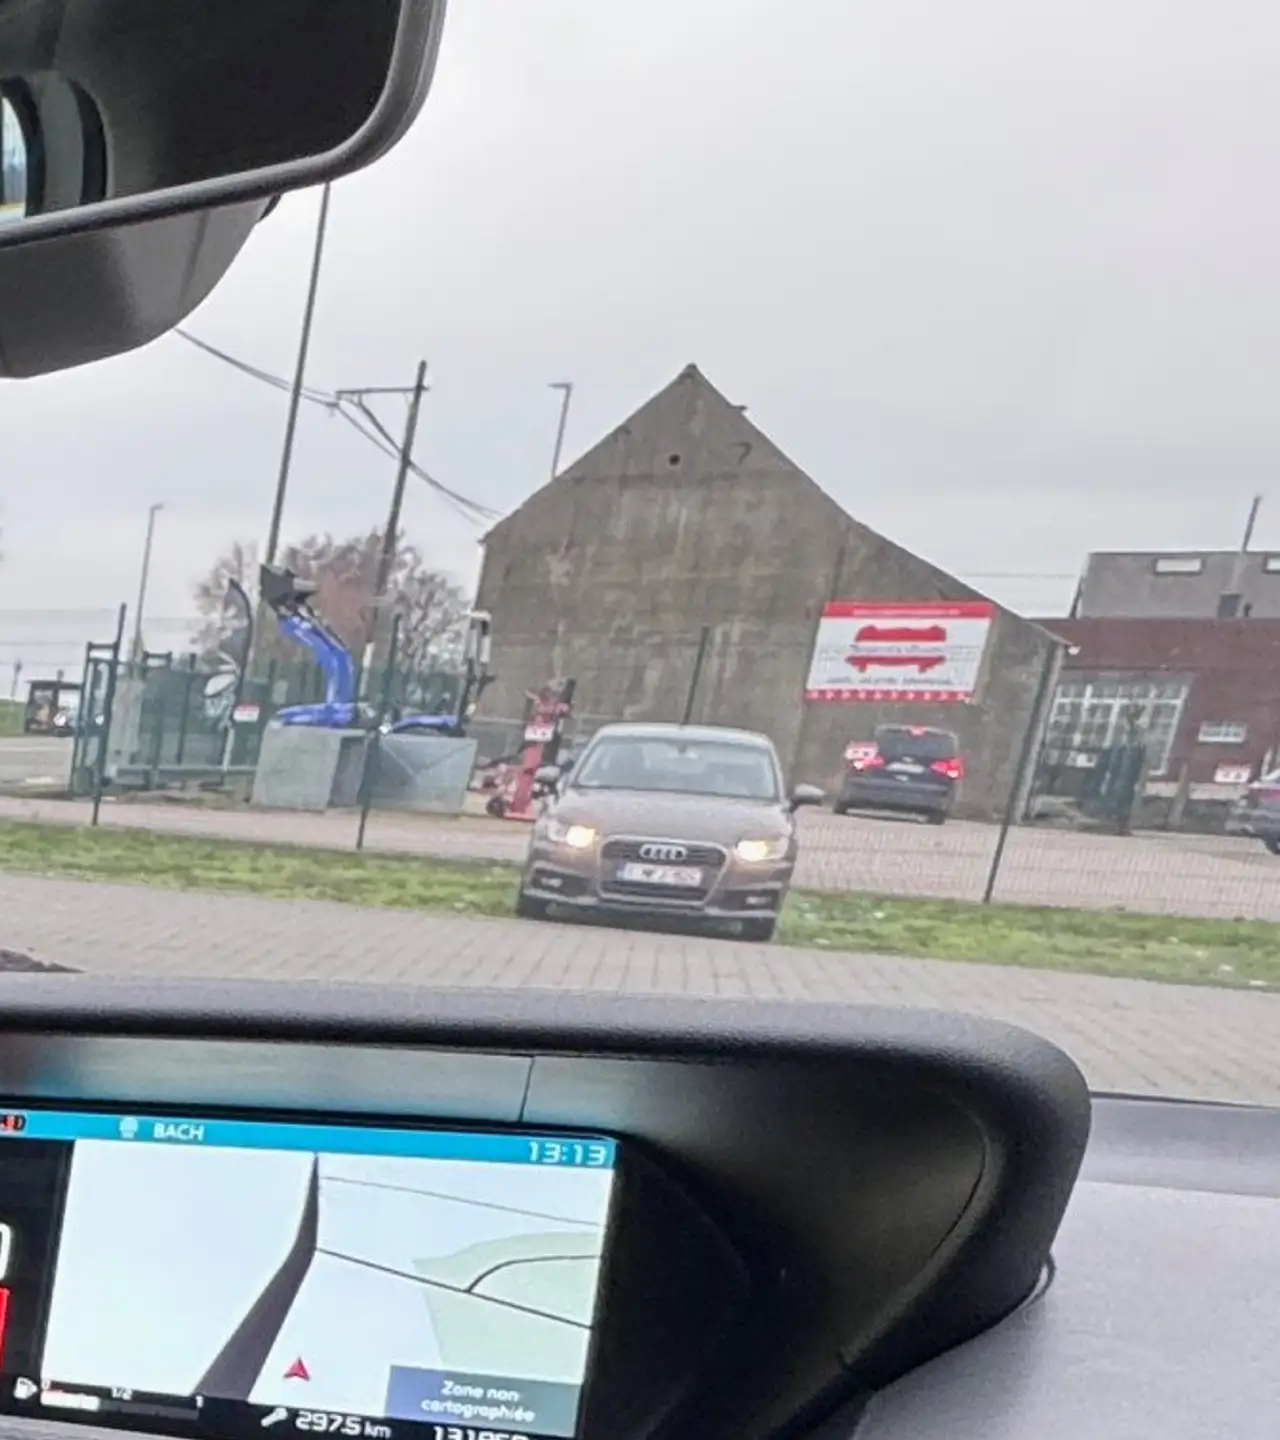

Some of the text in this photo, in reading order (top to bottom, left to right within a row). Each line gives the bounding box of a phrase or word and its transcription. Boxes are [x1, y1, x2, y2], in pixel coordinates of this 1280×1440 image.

[153, 1121, 205, 1142] BACH
[528, 1140, 608, 1166] 13:13
[441, 1380, 520, 1403] Zone non
[363, 1420, 392, 1440] km
